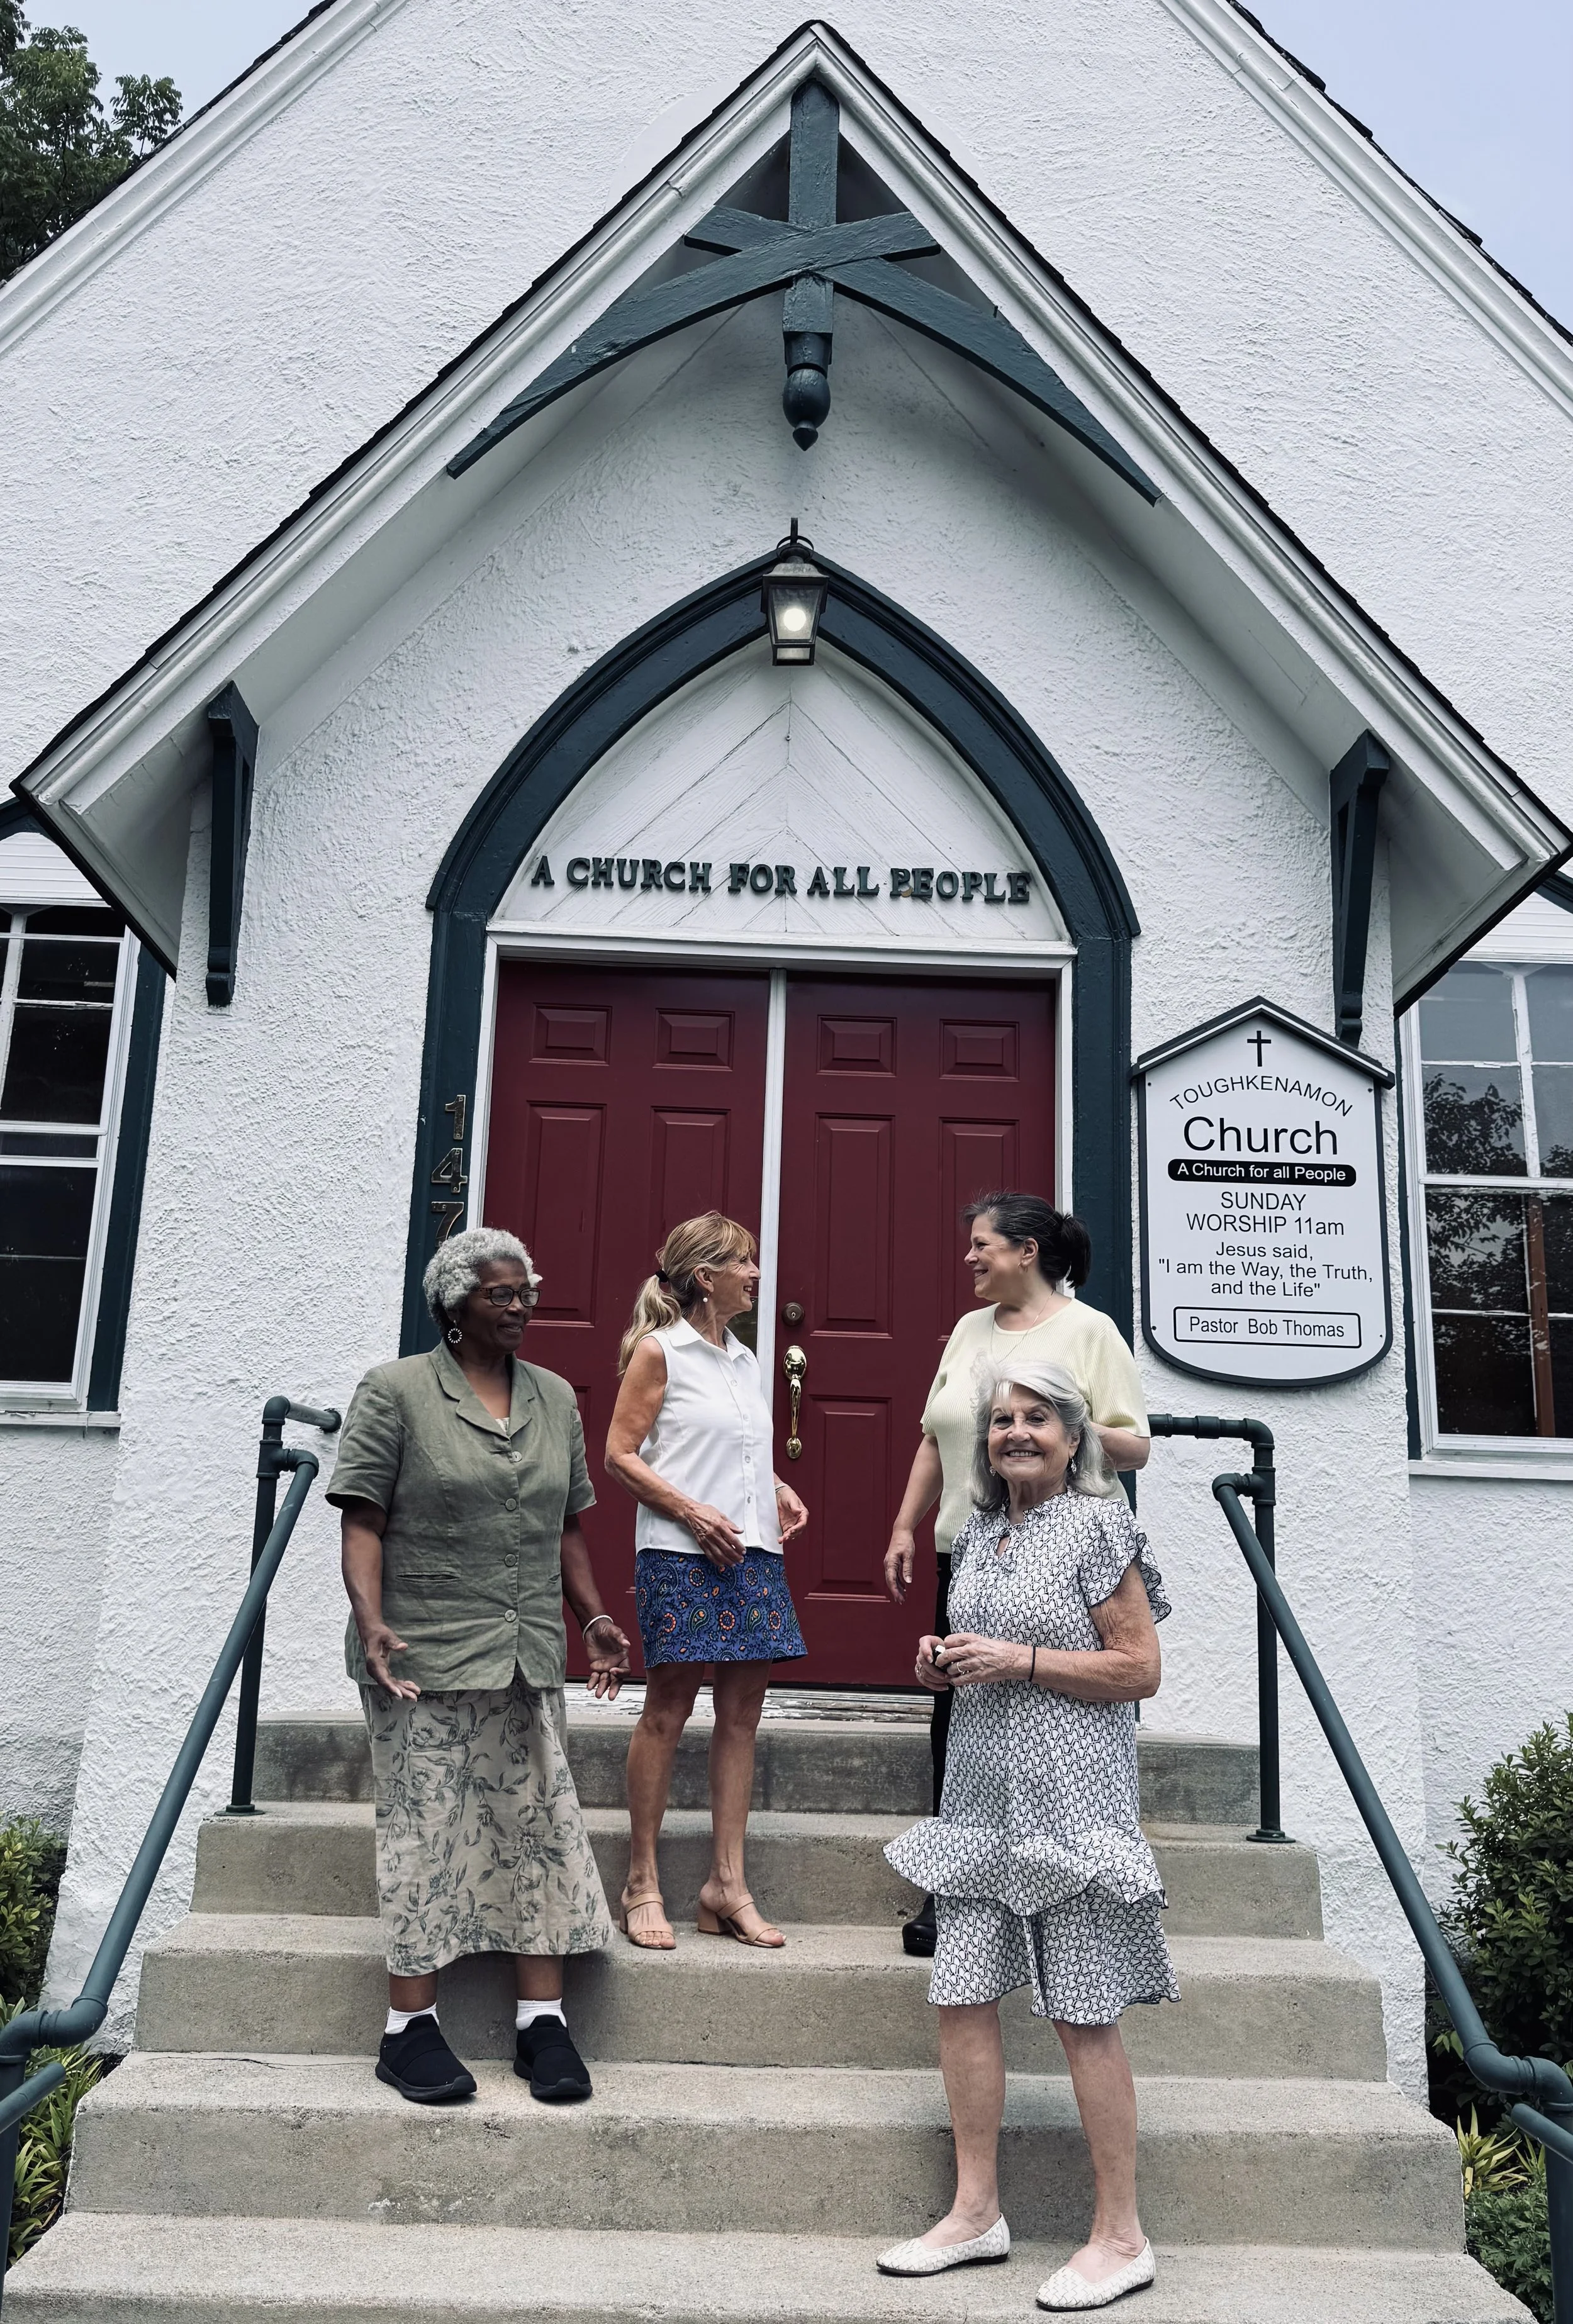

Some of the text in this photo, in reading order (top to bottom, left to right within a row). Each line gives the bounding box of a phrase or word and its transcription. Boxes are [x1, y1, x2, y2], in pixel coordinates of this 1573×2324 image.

[530, 855, 1030, 902] A CHURCH FOR ALL PEOPLE
[1170, 1075, 1353, 1117] TOUGHKENAMON
[1184, 1116, 1338, 1155] Church
[1178, 1163, 1346, 1183] A Church for all People
[1221, 1191, 1307, 1211] SUNDAY
[1187, 1213, 1344, 1236] WORSHIP 11am
[1216, 1241, 1314, 1261] Jesus said,
[1158, 1258, 1372, 1283] "I am the Way, the Truth,
[1211, 1280, 1320, 1297] and the Life"
[1190, 1316, 1345, 1338] Pastor Bob Thomas
